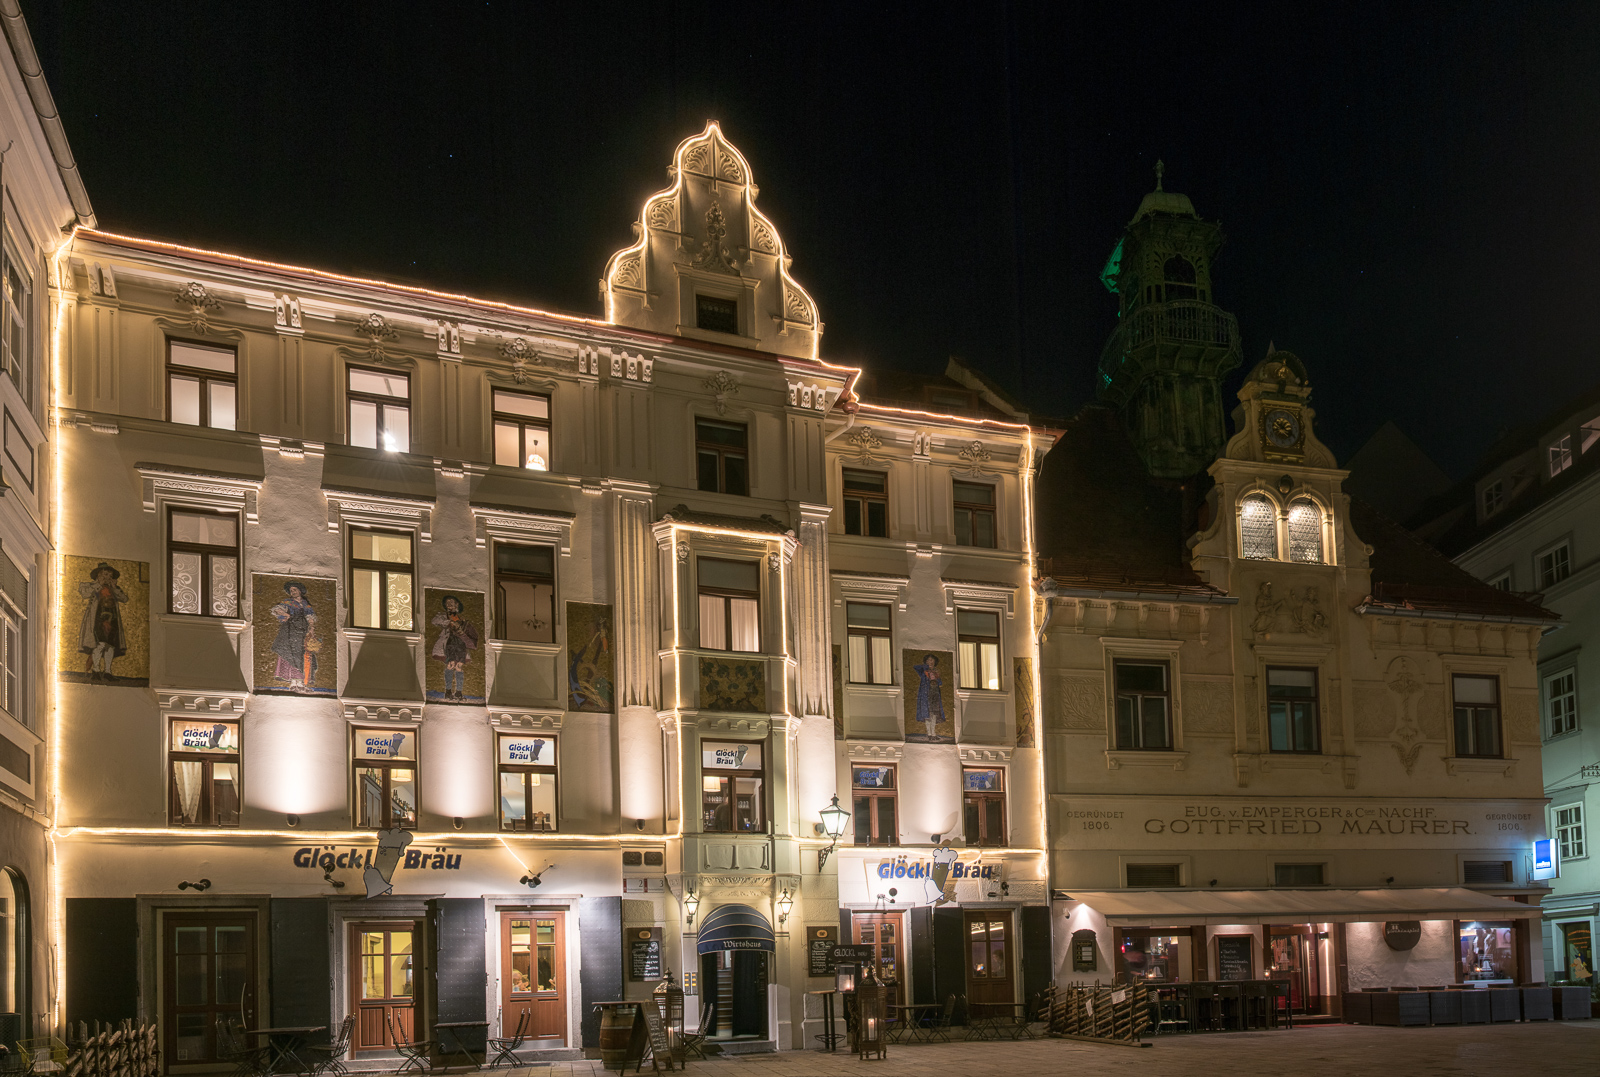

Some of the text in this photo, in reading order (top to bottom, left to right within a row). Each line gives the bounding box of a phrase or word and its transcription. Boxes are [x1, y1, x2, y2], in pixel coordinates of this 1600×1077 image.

[183, 729, 212, 738] Glöckl
[183, 738, 207, 747] Bräu
[366, 737, 392, 746] Glöckl
[366, 746, 387, 755] Bräu
[509, 743, 533, 752] Glöckl
[509, 752, 529, 760] Bräu
[716, 749, 738, 757] Glöckl
[716, 757, 734, 765] Bräu
[1066, 810, 1125, 819] GEGRÜNDET
[1185, 806, 1226, 818] EUG.
[1241, 807, 1342, 818] EMPERGER
[1379, 808, 1437, 818] NACHF.
[1485, 812, 1532, 821] GEGRÜNDET
[1082, 821, 1113, 831] 1806.
[1144, 819, 1478, 835] GOTTFRIED MAURER.
[1497, 823, 1523, 831] 1806.
[293, 845, 462, 870] Glöckl Bräu
[878, 859, 993, 879] Glöckl Bräu
[723, 941, 761, 949] Wirtshaus
